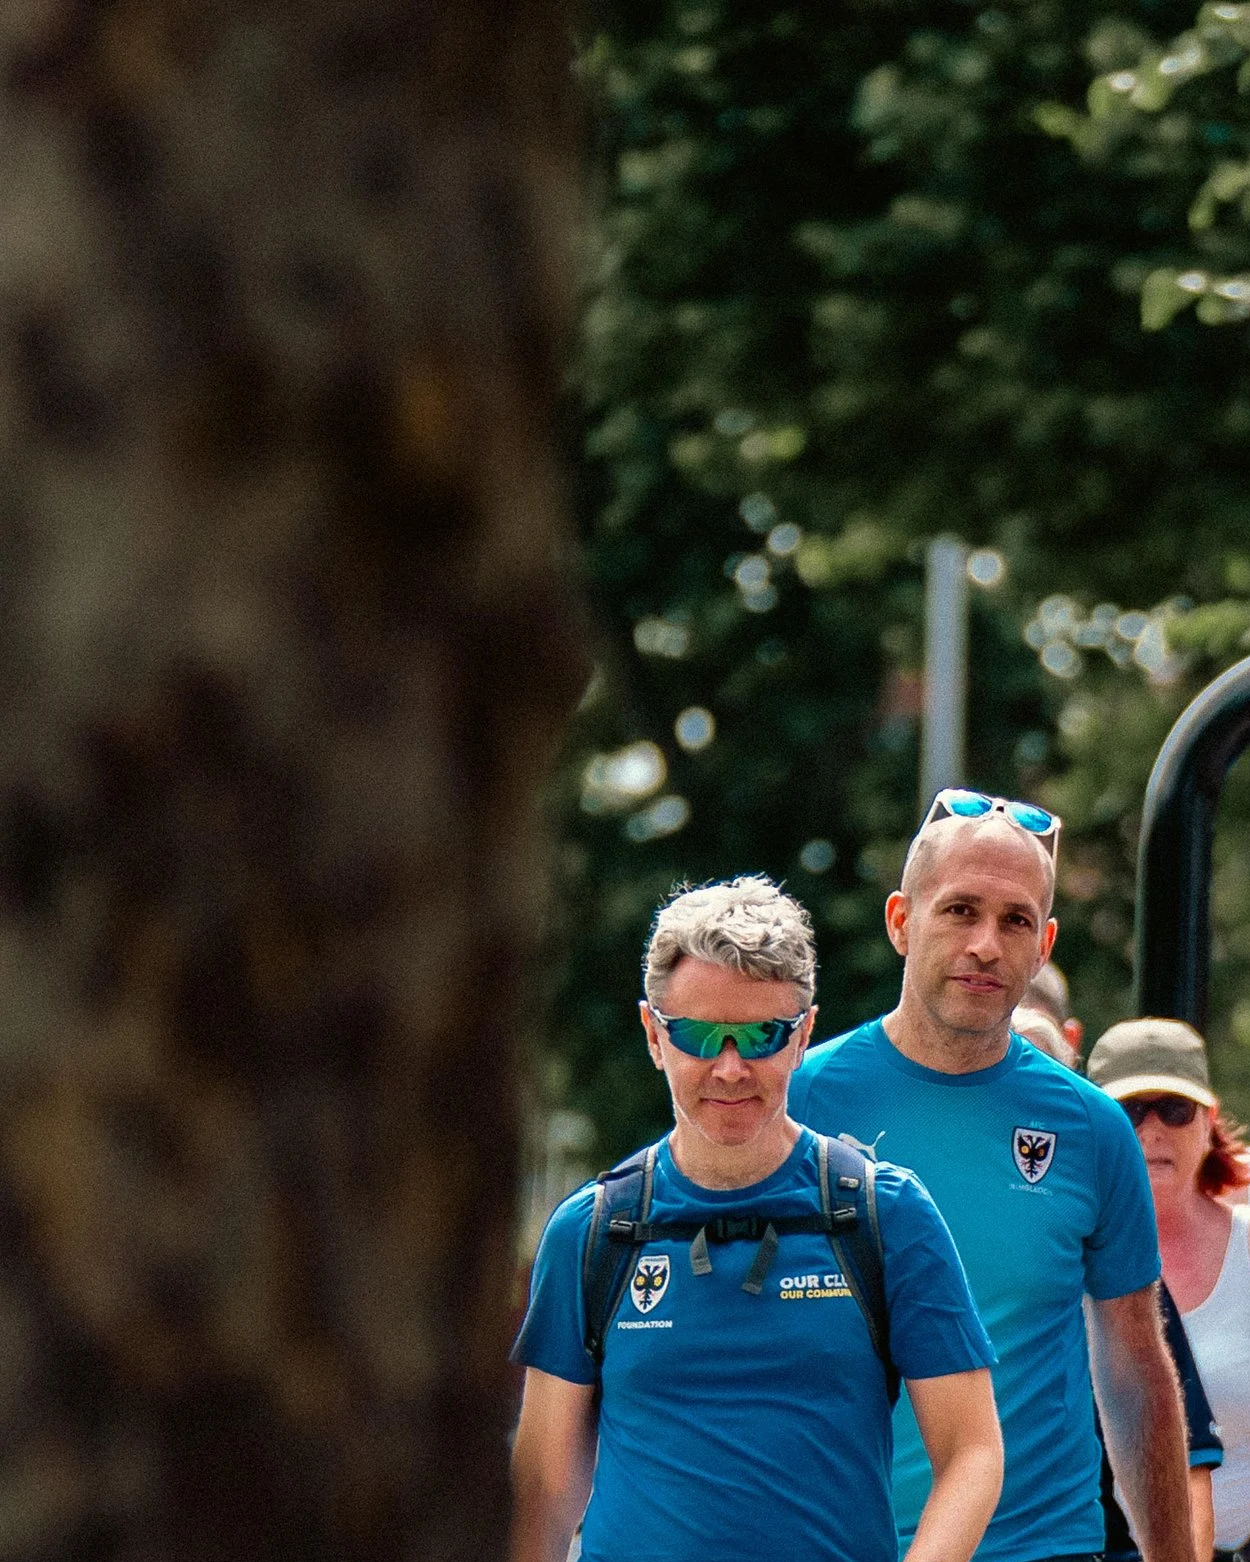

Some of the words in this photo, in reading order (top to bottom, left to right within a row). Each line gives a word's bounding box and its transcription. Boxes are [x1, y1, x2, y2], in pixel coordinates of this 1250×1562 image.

[780, 1275, 819, 1289] OUR
[780, 1290, 804, 1299] OUR
[617, 1320, 673, 1330] FOUNDATION
